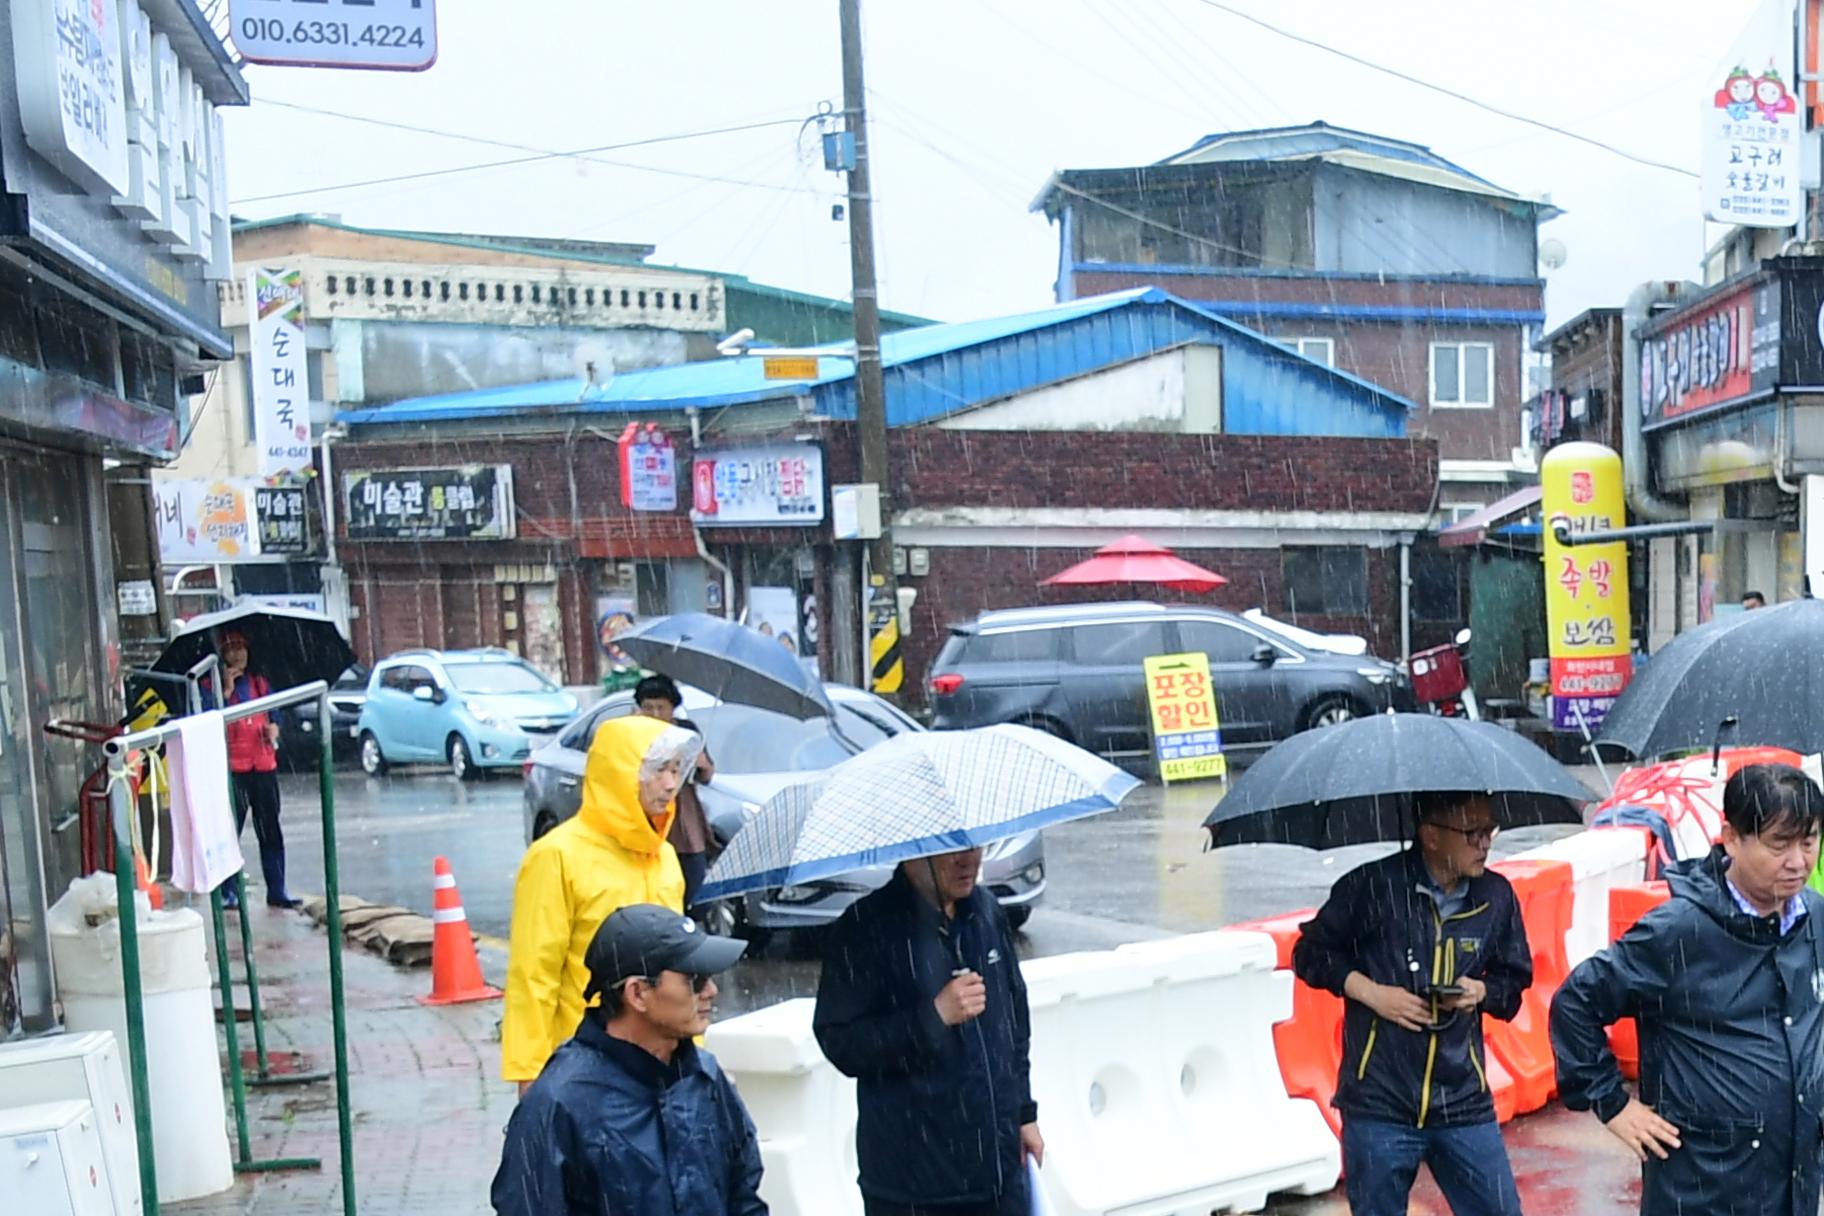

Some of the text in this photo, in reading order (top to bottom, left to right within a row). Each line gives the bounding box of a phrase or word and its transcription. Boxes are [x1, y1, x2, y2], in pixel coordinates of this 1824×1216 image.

[241, 17, 425, 49] 010.6331.4224
[1728, 145, 1782, 168] 고구려
[270, 326, 295, 431] 순대국
[363, 480, 424, 515] 미술관
[1559, 557, 1612, 599] 족발
[1562, 619, 1616, 646] 보쌈
[1153, 672, 1205, 699] 포장
[1157, 701, 1211, 730] 할인
